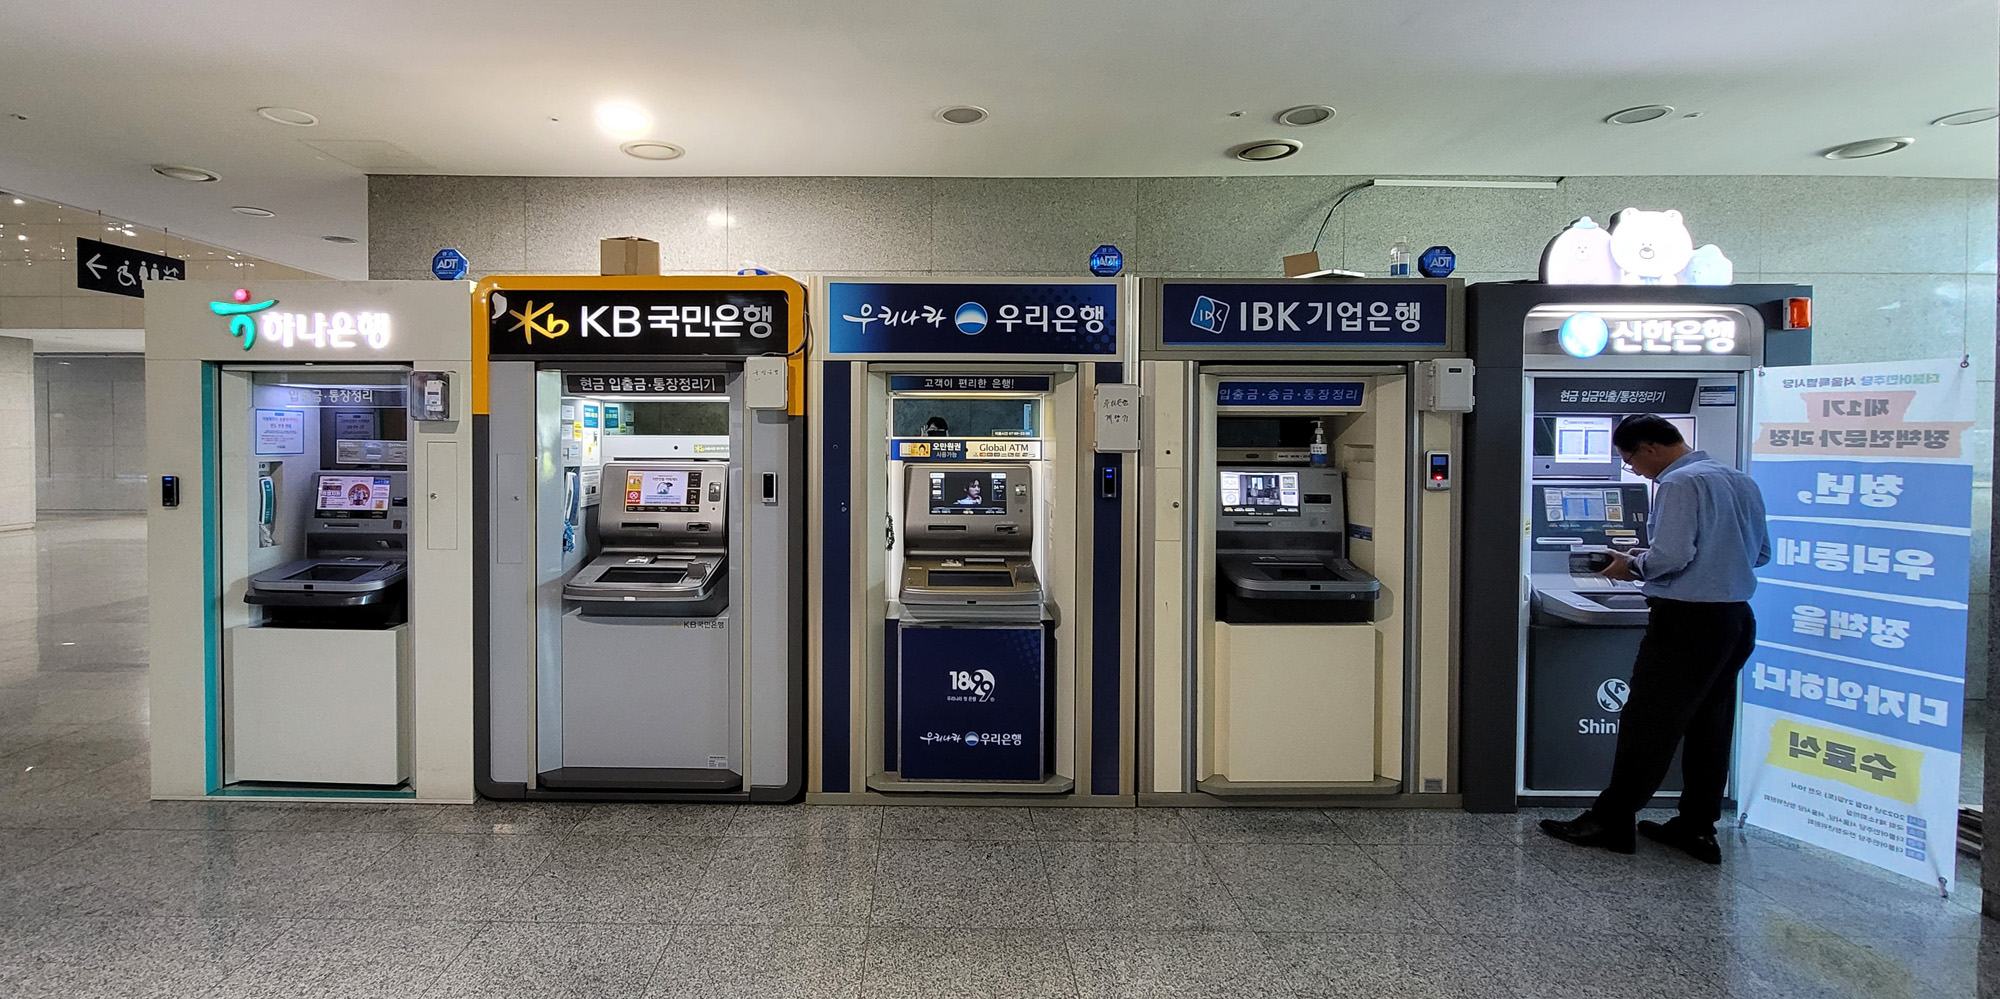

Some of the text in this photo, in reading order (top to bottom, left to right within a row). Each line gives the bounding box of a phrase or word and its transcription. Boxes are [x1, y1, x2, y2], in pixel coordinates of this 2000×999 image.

[437, 258, 458, 269] ADT
[1100, 255, 1118, 267] ADT
[1430, 257, 1451, 267] ADT
[842, 303, 1105, 334] 우리나라 우리은행
[260, 312, 392, 350] 하나은행
[1611, 318, 1736, 354] 신한은행
[579, 376, 716, 392] 현금 입출금·통장정리기
[924, 378, 1015, 390] 고객이 편리한 은행!
[1560, 389, 1579, 403] 현금
[932, 442, 961, 451] 오만원권
[979, 443, 1029, 452] Global ATM
[949, 669, 995, 702] 1899
[1578, 718, 1620, 734] Shin
[920, 731, 1022, 746] 우리나라 우리은행
